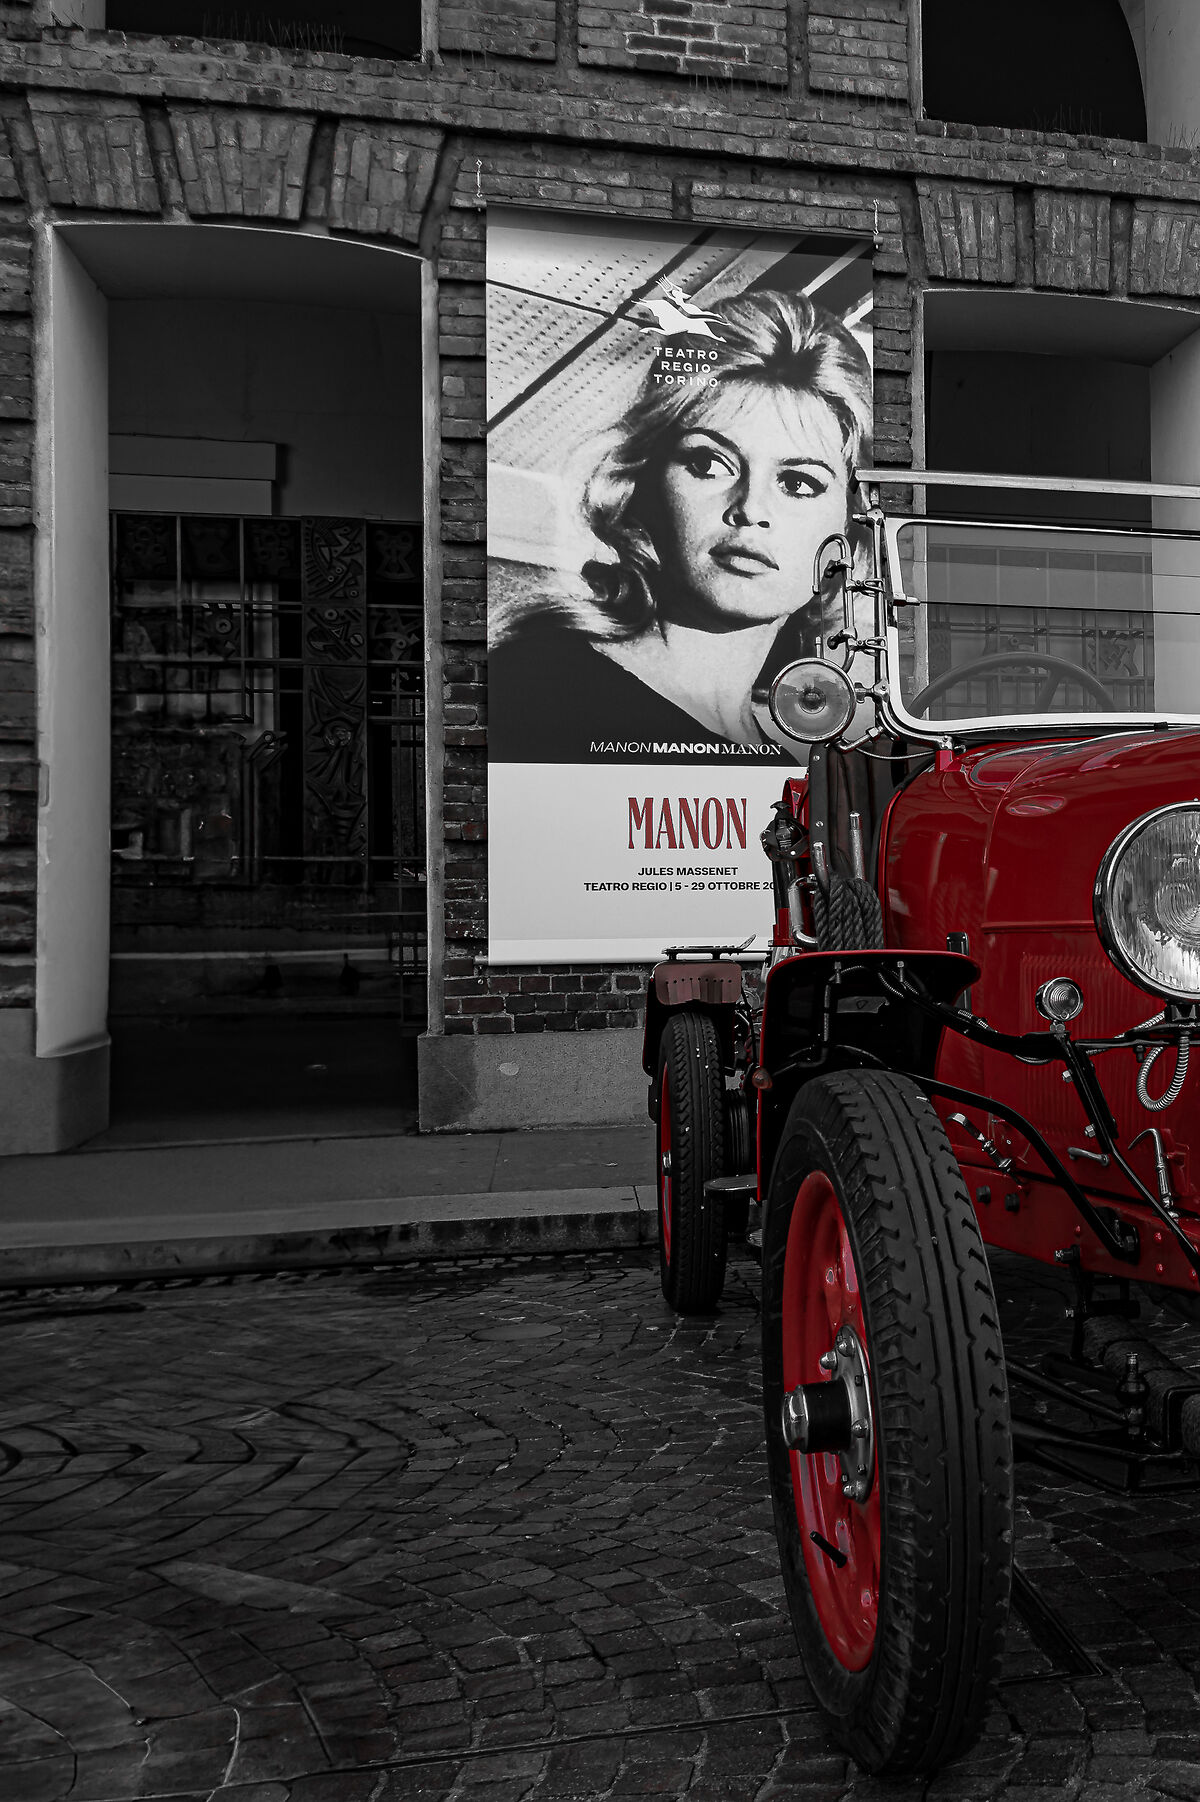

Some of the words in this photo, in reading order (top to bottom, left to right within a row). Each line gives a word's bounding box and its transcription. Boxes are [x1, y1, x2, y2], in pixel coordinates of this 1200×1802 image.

[653, 346, 718, 361] TEATRO
[661, 360, 711, 374] REGIO
[653, 373, 718, 388] TORINO
[589, 741, 652, 753] MANON
[653, 742, 720, 754] MANON
[721, 743, 783, 756] MANON
[627, 797, 748, 850] MANON
[637, 867, 674, 876] JULES
[676, 867, 738, 876] MASSENET
[584, 882, 629, 891] TEATRO
[632, 882, 667, 891] REGIO
[674, 882, 682, 890] 5
[691, 882, 705, 891] 29
[707, 881, 760, 890] OTTOBRE
